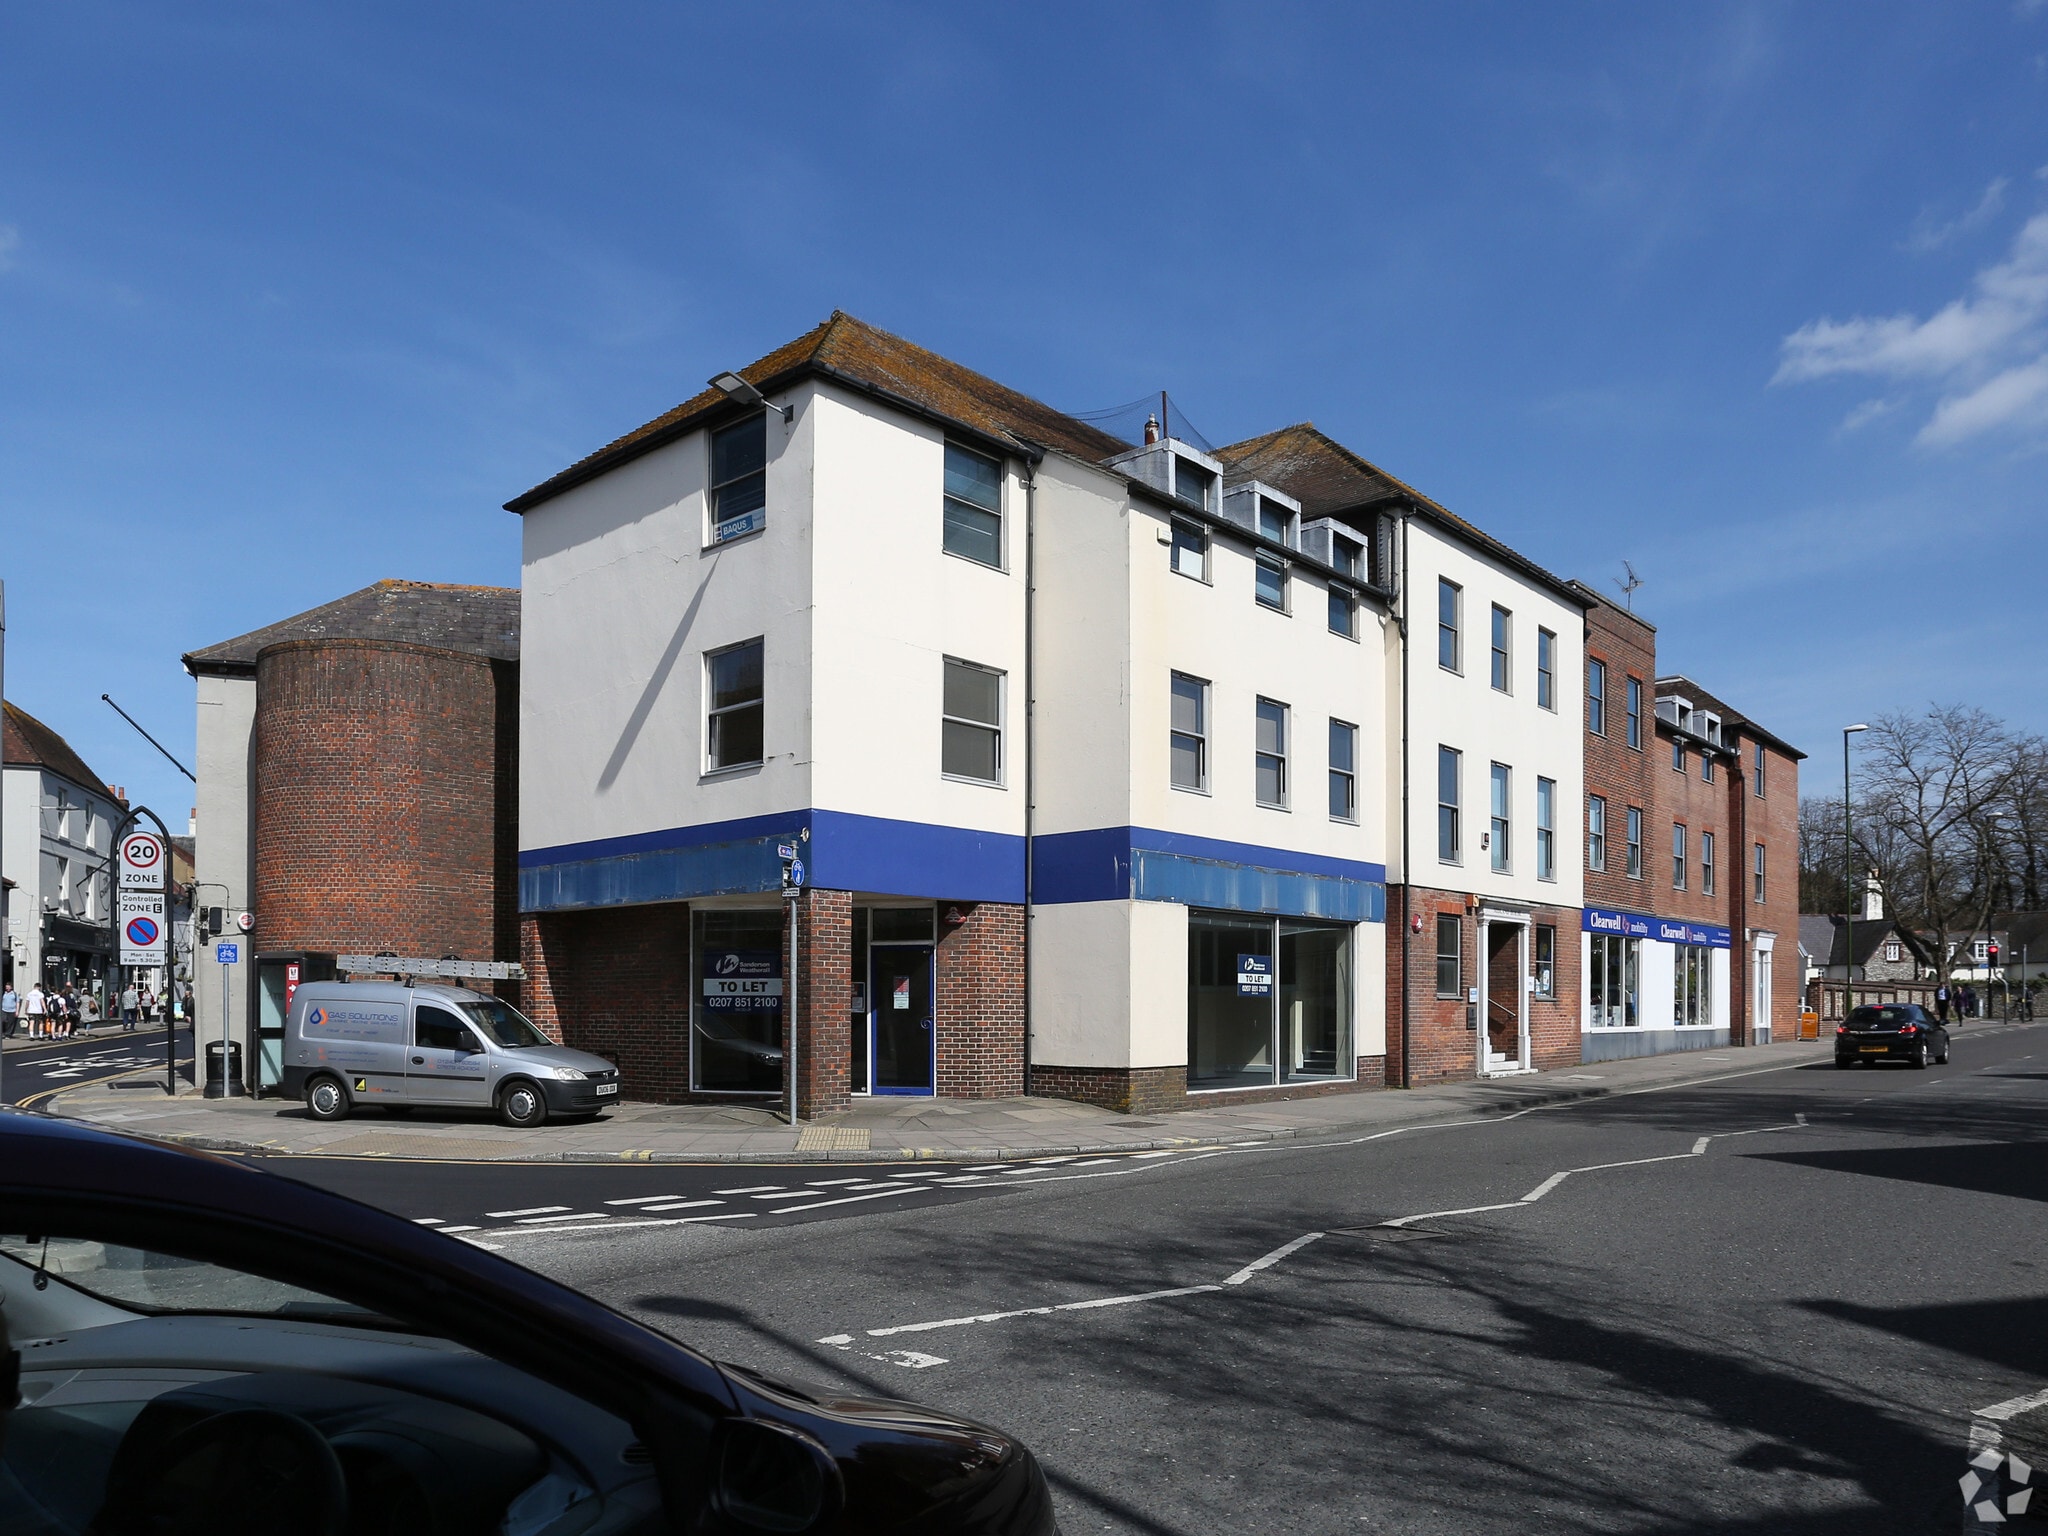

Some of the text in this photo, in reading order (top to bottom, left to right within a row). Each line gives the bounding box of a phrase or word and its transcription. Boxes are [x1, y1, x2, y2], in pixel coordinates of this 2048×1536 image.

[723, 519, 747, 536] BAQUS
[130, 845, 154, 858] 20
[125, 874, 158, 883] ZONE
[122, 894, 162, 903] Controlled
[122, 904, 161, 913] ZONE E
[1590, 912, 1649, 936] Clearwell mobility
[1660, 924, 1708, 945] Clearwell mobility
[1254, 975, 1265, 983] LET
[718, 981, 768, 993] TO LET
[709, 997, 778, 1007] 0207 851 2100
[328, 1011, 399, 1022] GAS SOLUTIONS
